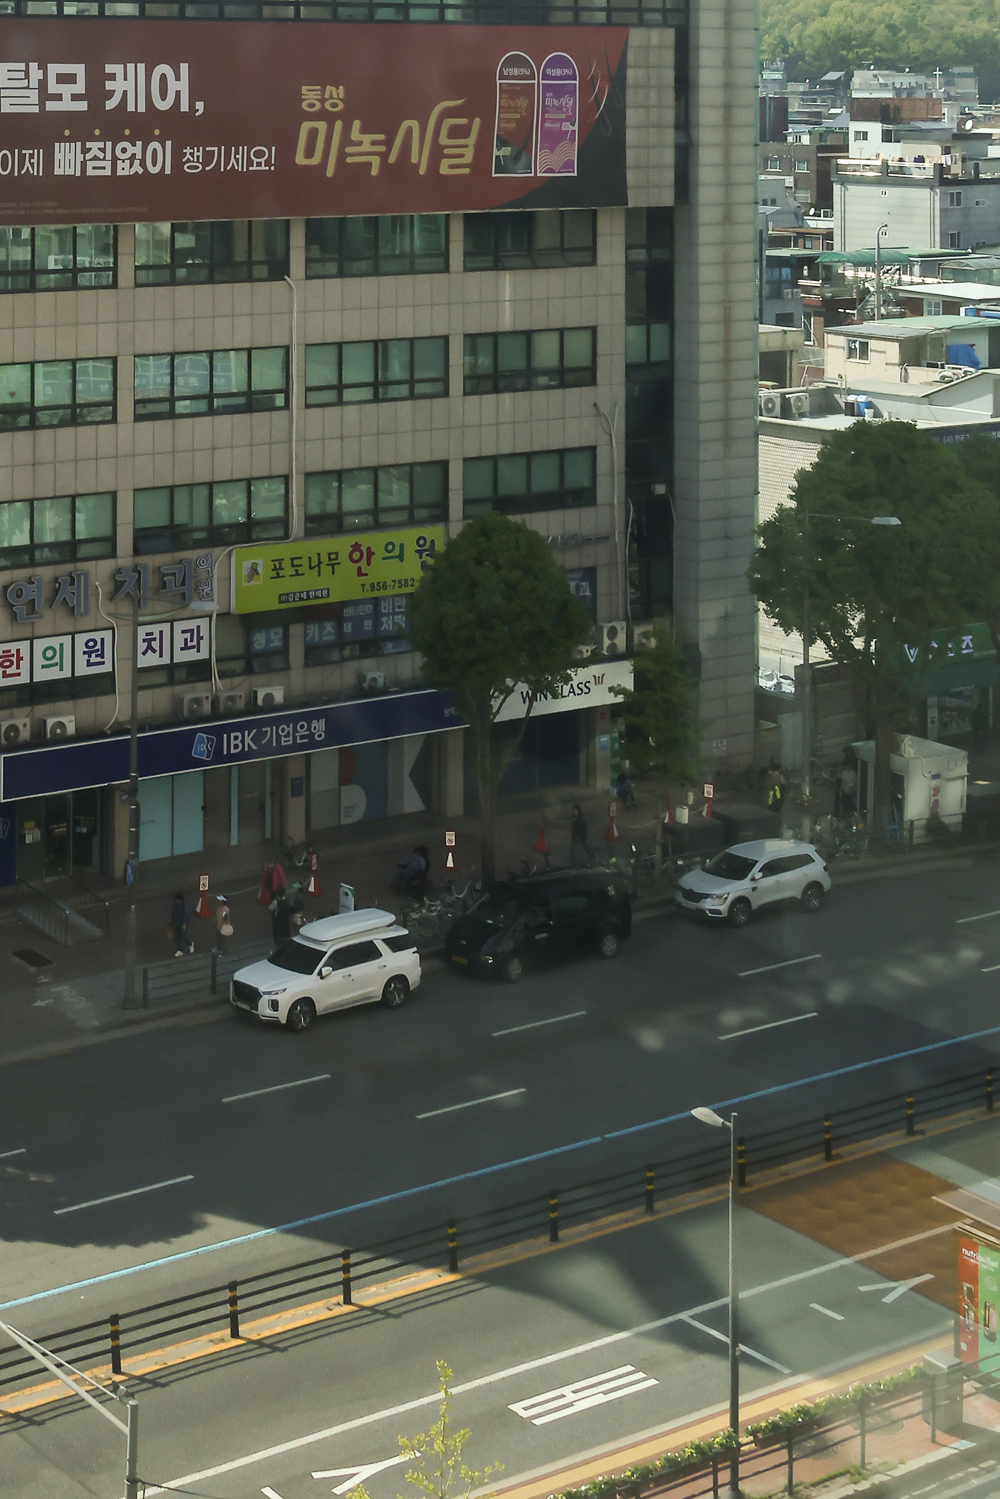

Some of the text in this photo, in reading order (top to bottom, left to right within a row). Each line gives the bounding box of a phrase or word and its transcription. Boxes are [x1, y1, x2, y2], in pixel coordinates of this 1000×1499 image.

[103, 62, 206, 118] 케어,
[301, 84, 345, 112] 동성
[294, 96, 481, 178] 미녹시딜
[53, 140, 173, 177] 빠짐없이
[182, 145, 277, 176] 챙기세요!
[270, 551, 341, 580] 포도나무
[6, 571, 90, 623] 연세
[111, 559, 196, 608] 치과
[141, 624, 204, 659] 치과
[223, 718, 326, 755] IBK 기업은행
